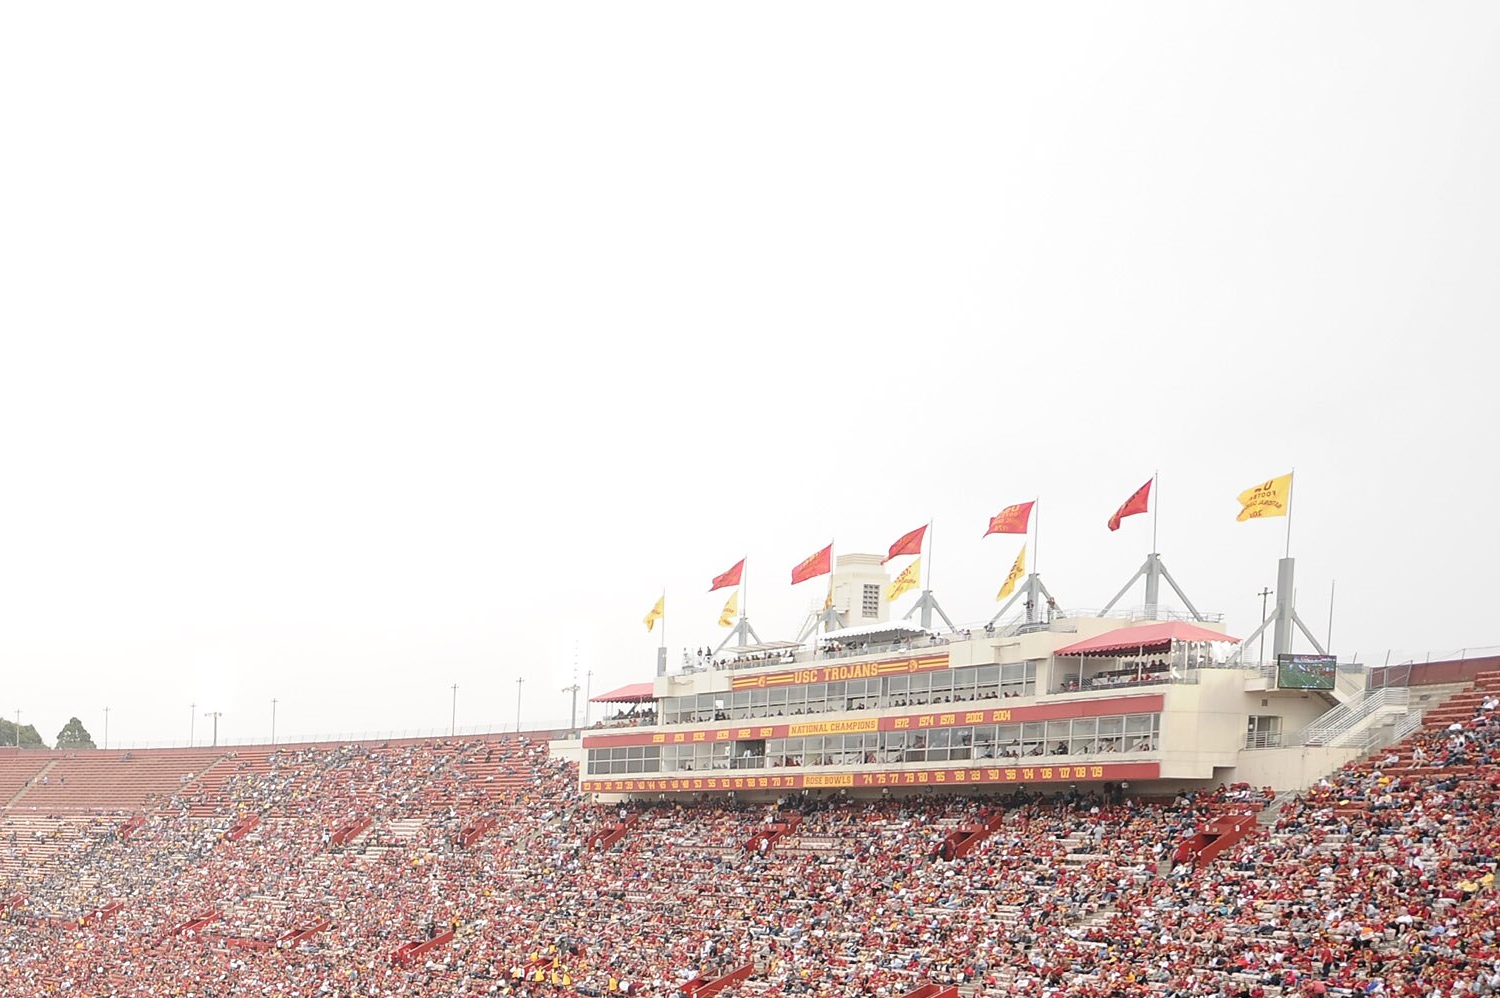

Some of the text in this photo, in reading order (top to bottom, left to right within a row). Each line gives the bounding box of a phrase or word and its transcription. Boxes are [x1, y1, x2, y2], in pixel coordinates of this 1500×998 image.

[794, 663, 879, 683] USC TROJANS
[791, 720, 876, 734] NATIONAL CHAMPIONS
[894, 718, 910, 728] 1972
[918, 716, 934, 726] 1974
[993, 710, 1011, 721] 2004
[806, 775, 851, 785] ROSE BOWLS
